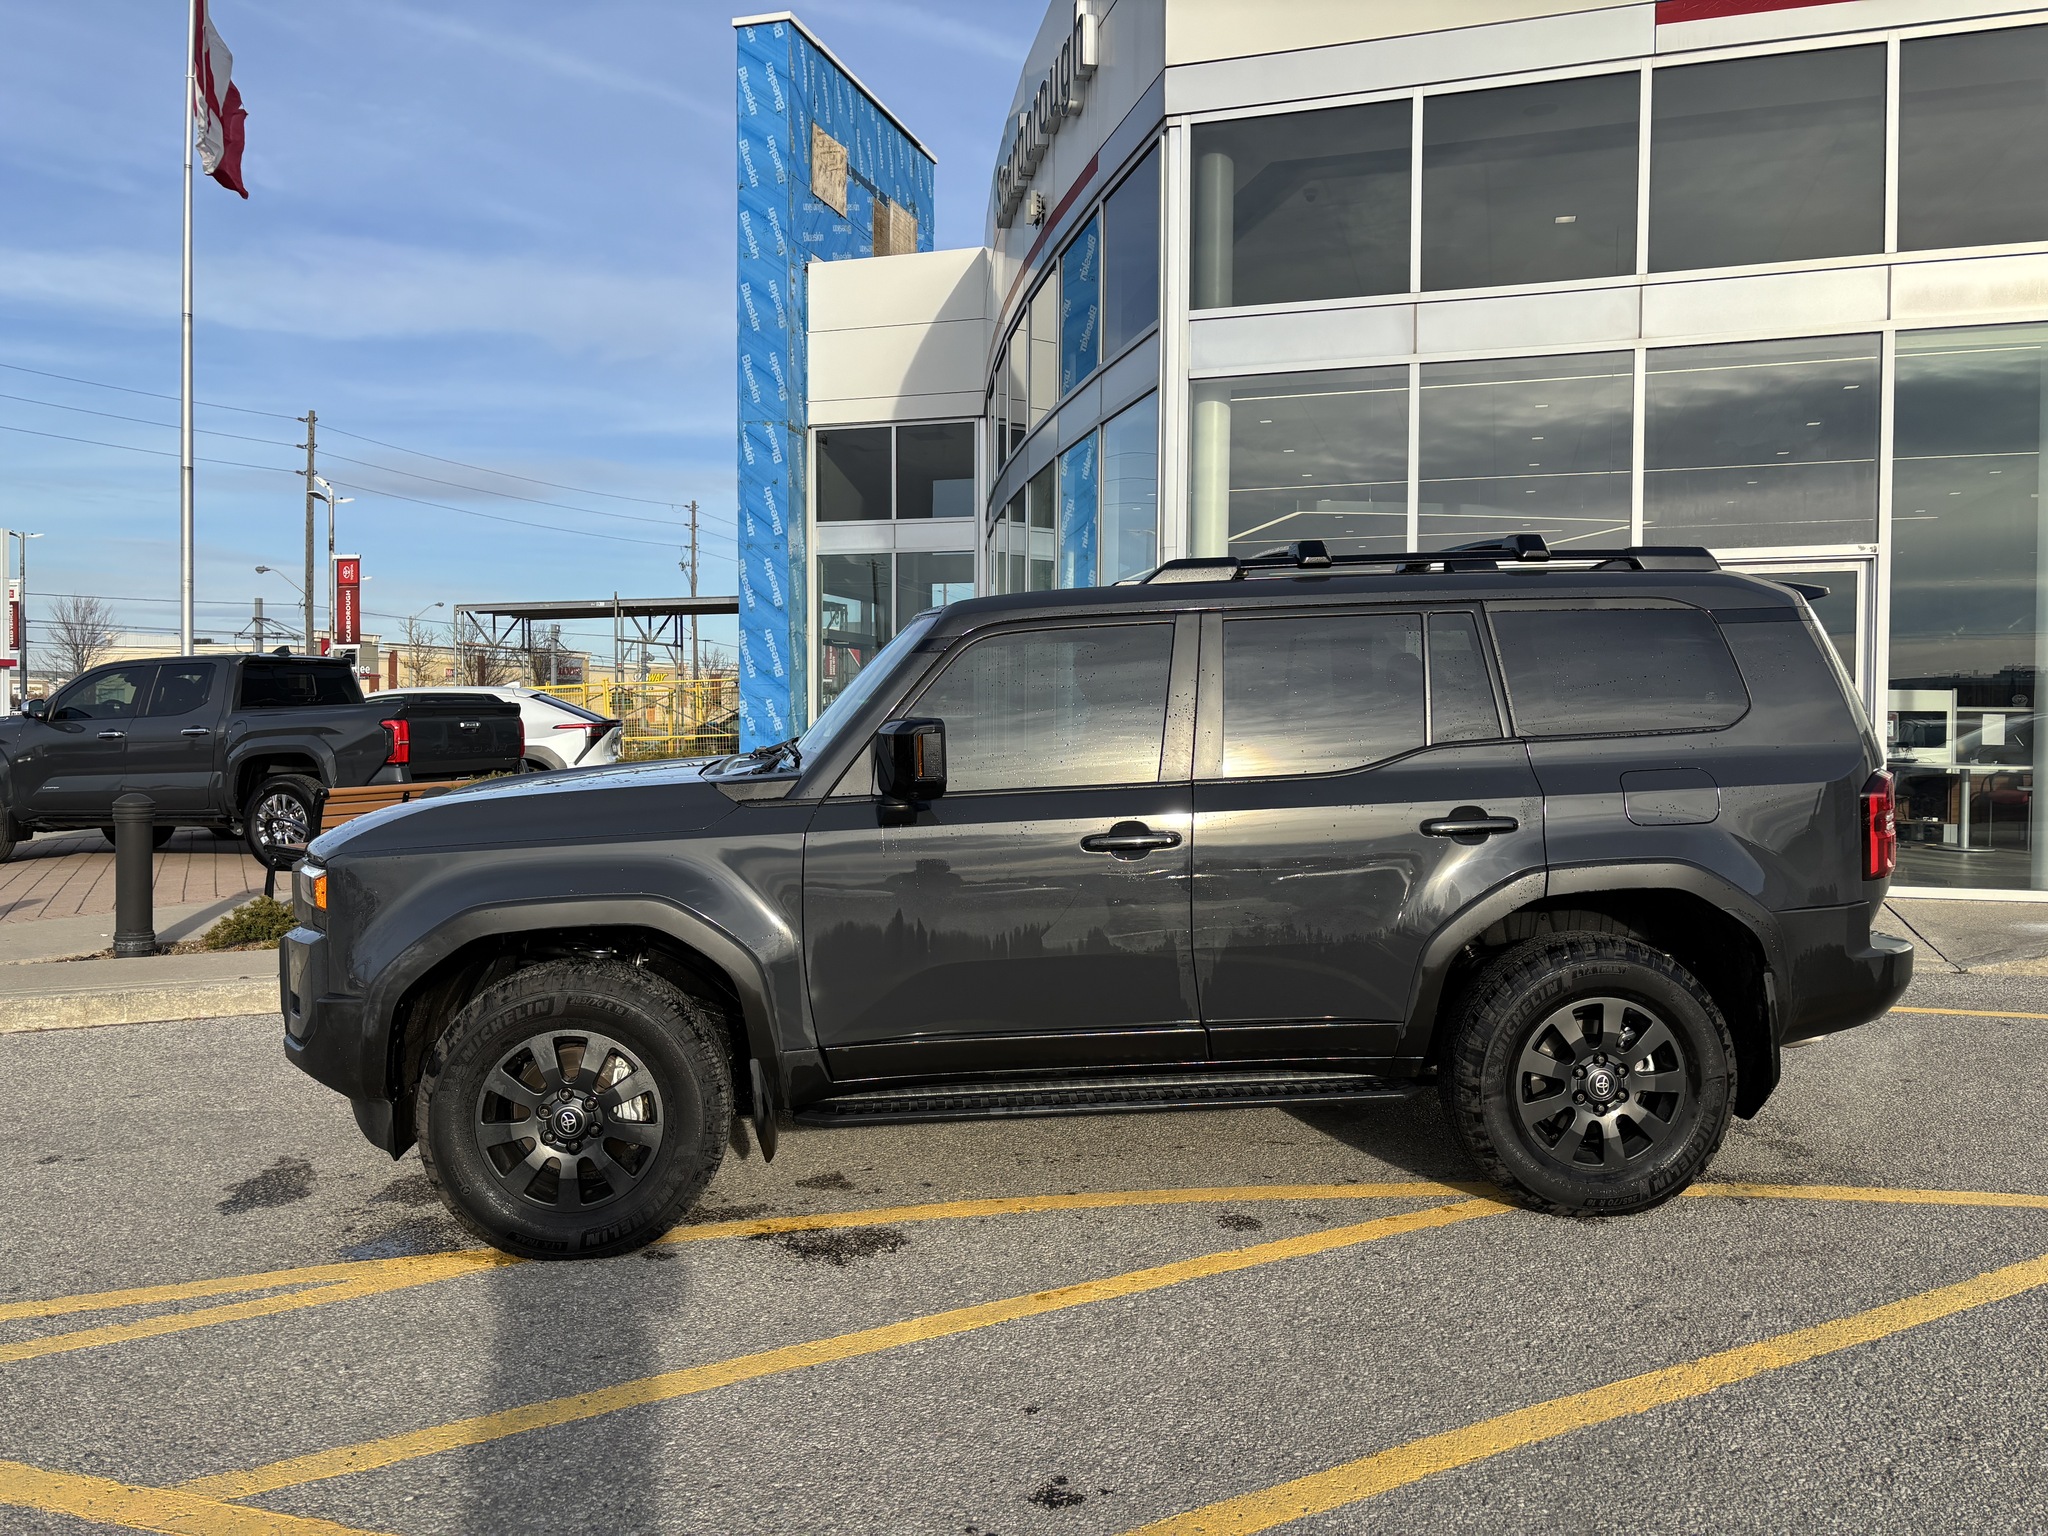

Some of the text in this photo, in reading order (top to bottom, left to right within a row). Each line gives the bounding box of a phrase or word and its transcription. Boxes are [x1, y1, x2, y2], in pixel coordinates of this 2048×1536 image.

[738, 66, 757, 116] Blueskin
[766, 62, 785, 112] Blueskin
[739, 139, 759, 188] Blueskin
[767, 135, 785, 185] Blueskin
[740, 210, 760, 260] Blueskin
[741, 282, 760, 332] Blueskin
[768, 279, 787, 329] Blueskin
[742, 354, 761, 404] Blueskin
[769, 352, 788, 402] Blueskin
[764, 486, 783, 536] Blueskin
[739, 558, 755, 608] Blueskin
[765, 557, 784, 607] Blueskin
[739, 629, 755, 679] Blueskin
[765, 628, 784, 678] Blueskin
[432, 744, 508, 755] TACOMA
[461, 1000, 550, 1061] MICHELIN
[1493, 978, 1563, 1061] MICHELIN
[1653, 1113, 1717, 1192] MICHELIN
[585, 1183, 674, 1247] MICHELIN
[1608, 1196, 1638, 1207] 265/70
